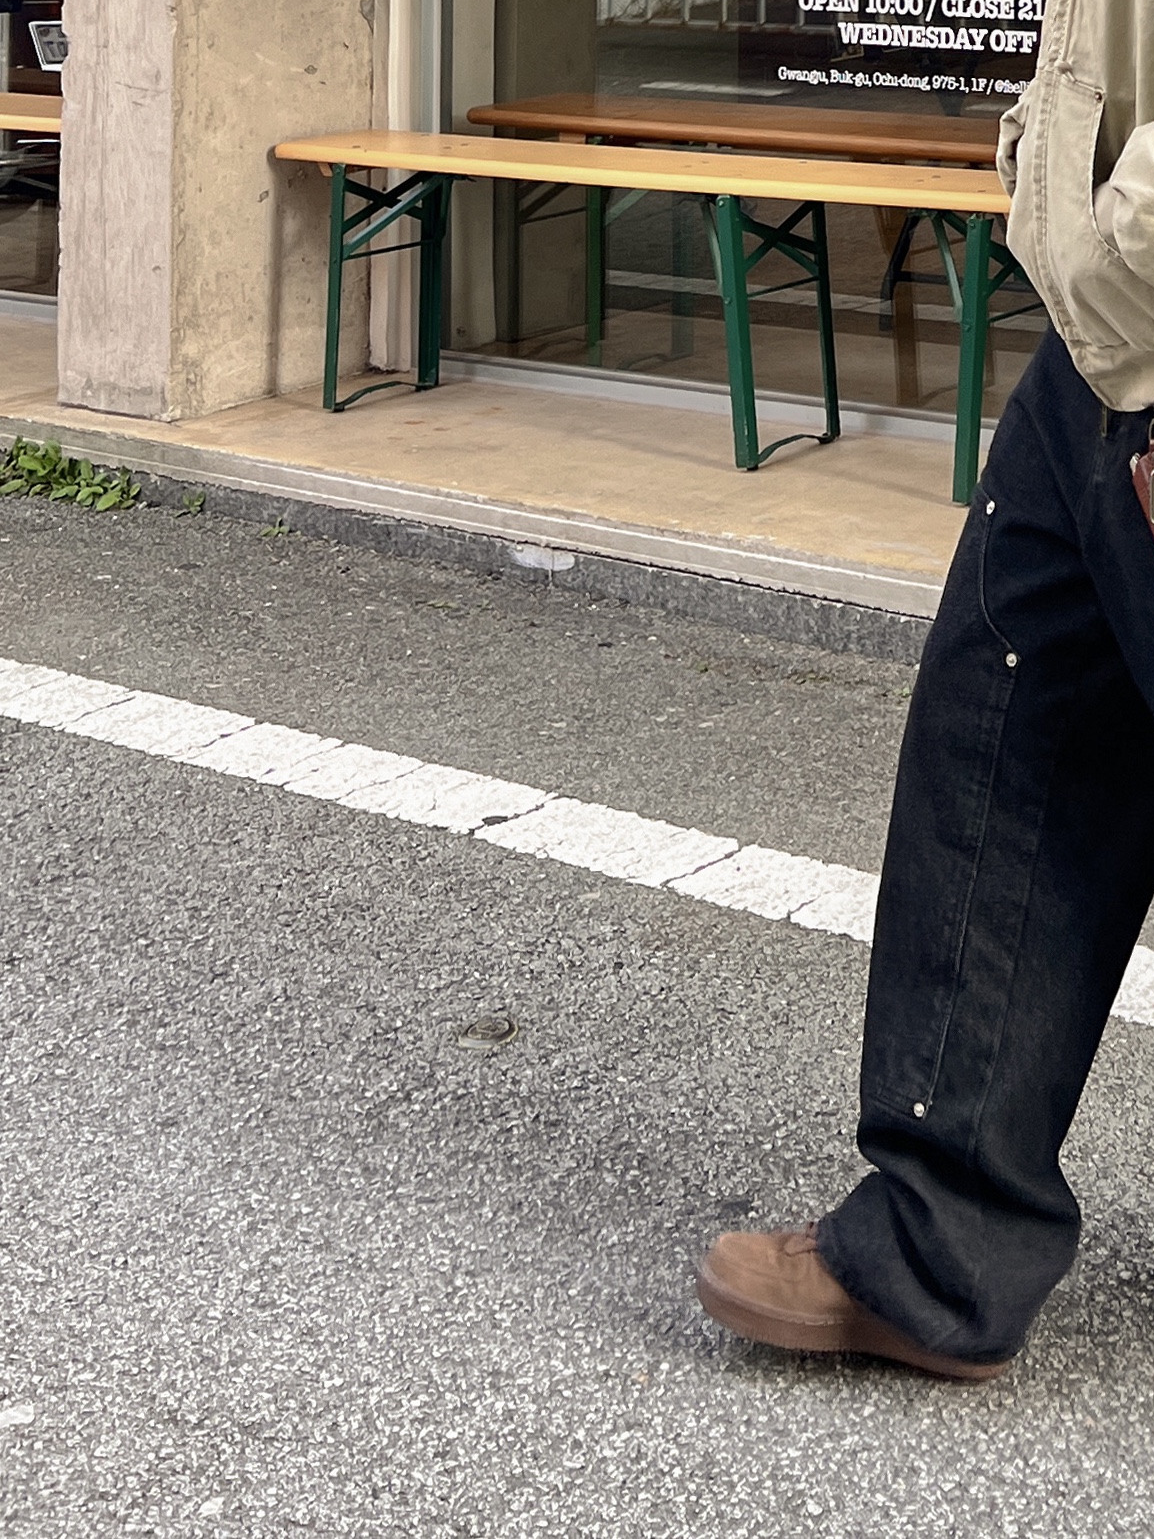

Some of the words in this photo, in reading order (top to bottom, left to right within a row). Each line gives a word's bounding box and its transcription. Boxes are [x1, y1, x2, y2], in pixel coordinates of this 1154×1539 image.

[838, 22, 988, 51] WEDNESDAY
[989, 29, 1038, 54] OFF
[830, 69, 873, 87] Buk-gu,
[932, 74, 969, 94] 975-1,
[970, 77, 988, 92] 1F
